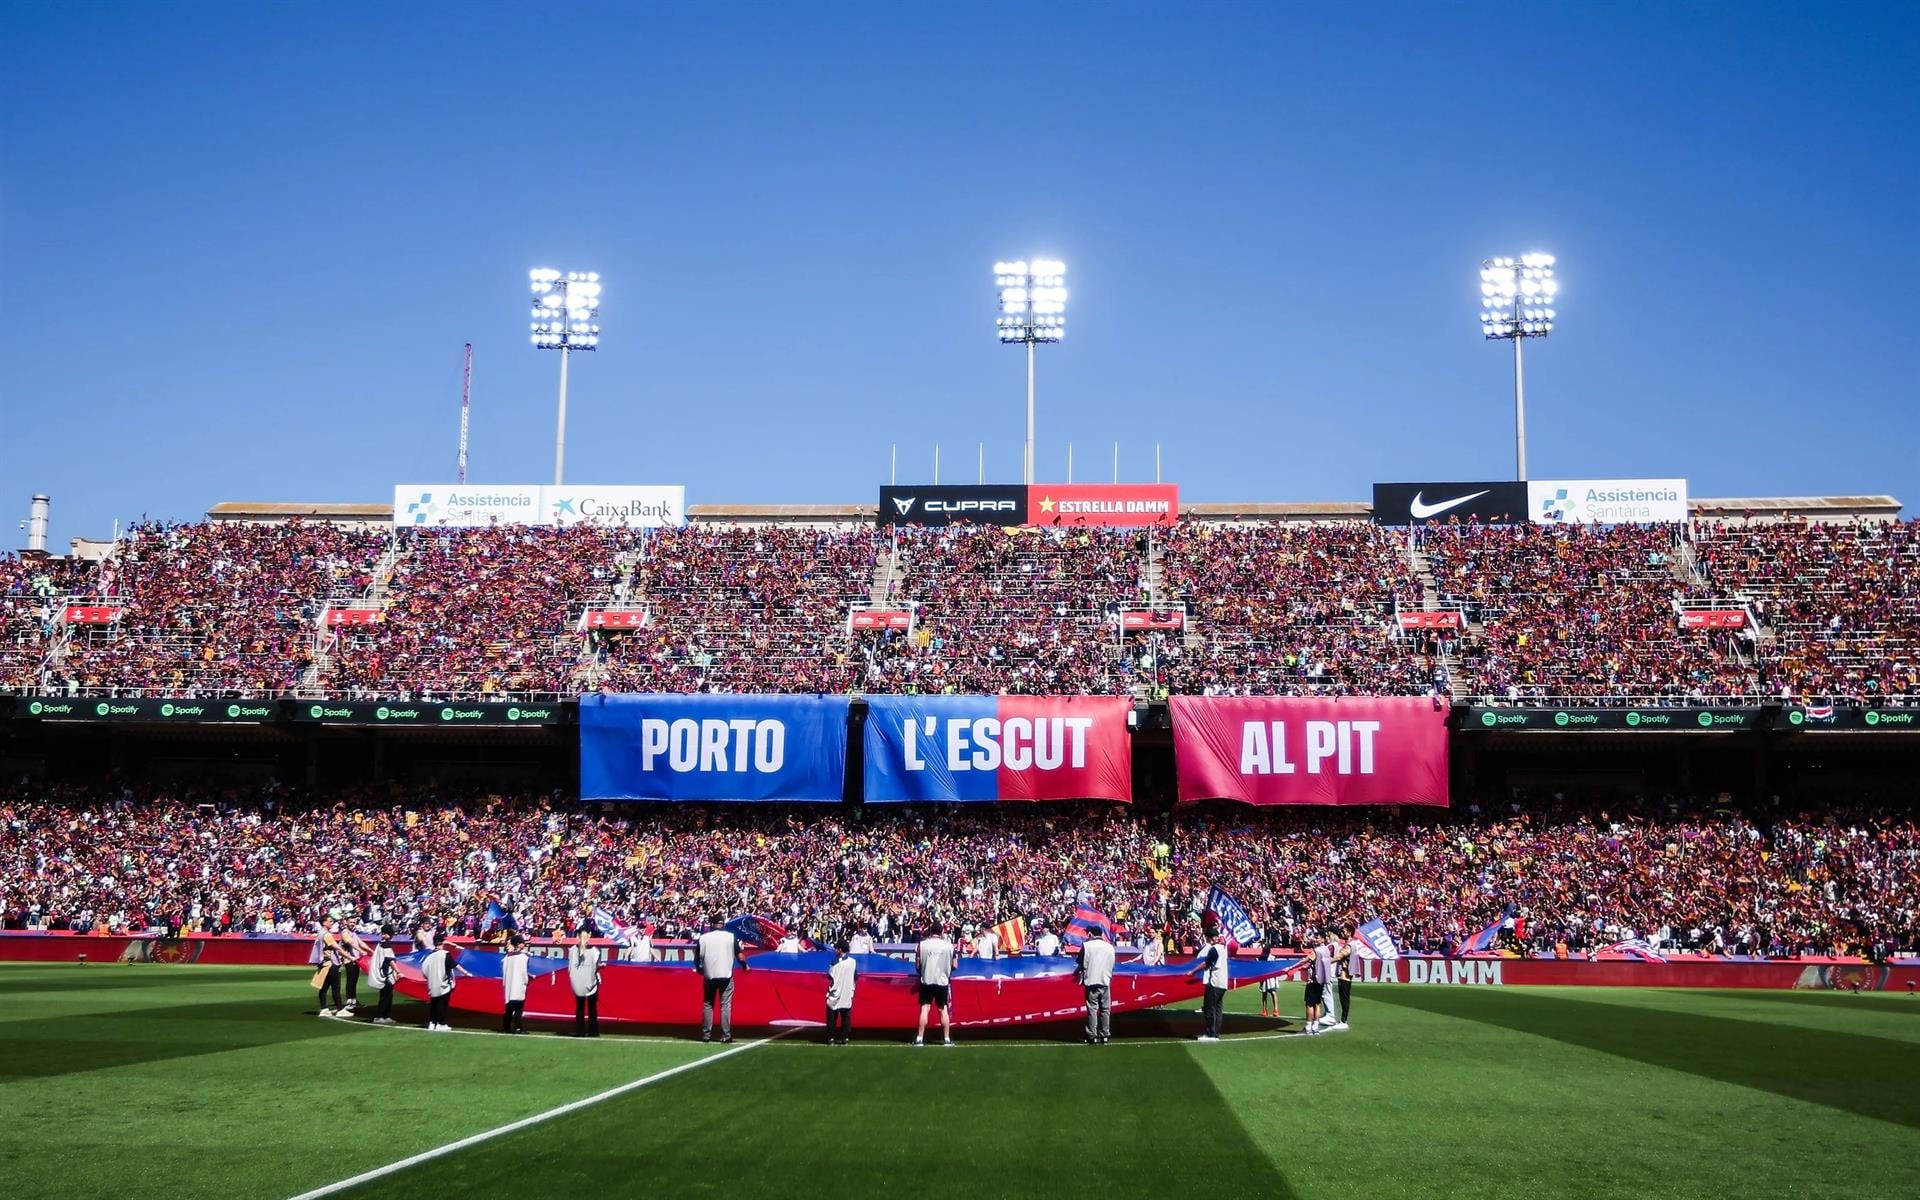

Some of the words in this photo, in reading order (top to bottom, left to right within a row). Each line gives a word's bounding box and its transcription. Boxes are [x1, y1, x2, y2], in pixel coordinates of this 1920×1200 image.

[448, 492, 532, 507] Assistència
[1585, 488, 1678, 503] Assistència
[579, 497, 672, 518] CaixaBank
[924, 500, 1016, 511] CUPRA
[1058, 501, 1124, 513] ESTRELLA
[1126, 501, 1170, 513] DAMM
[1586, 503, 1651, 519] Sanitària
[44, 705, 72, 714] Spotify
[110, 706, 139, 715] Spotify
[175, 707, 204, 716] Spotify
[242, 708, 271, 717] Spotify
[324, 709, 352, 718] Spotify
[390, 710, 419, 719] Spotify
[455, 710, 484, 719] Spotify
[521, 710, 550, 720] Spotify
[1497, 714, 1528, 725] Spotify
[1570, 714, 1600, 724] Spotify
[1641, 714, 1671, 724] Spotify
[1714, 715, 1744, 725] Spotify
[1880, 715, 1913, 725] Spotify
[641, 718, 785, 773] PORTO
[1240, 720, 1295, 774] AL
[1306, 720, 1380, 774] PIT
[1408, 959, 1504, 985] DAMM
